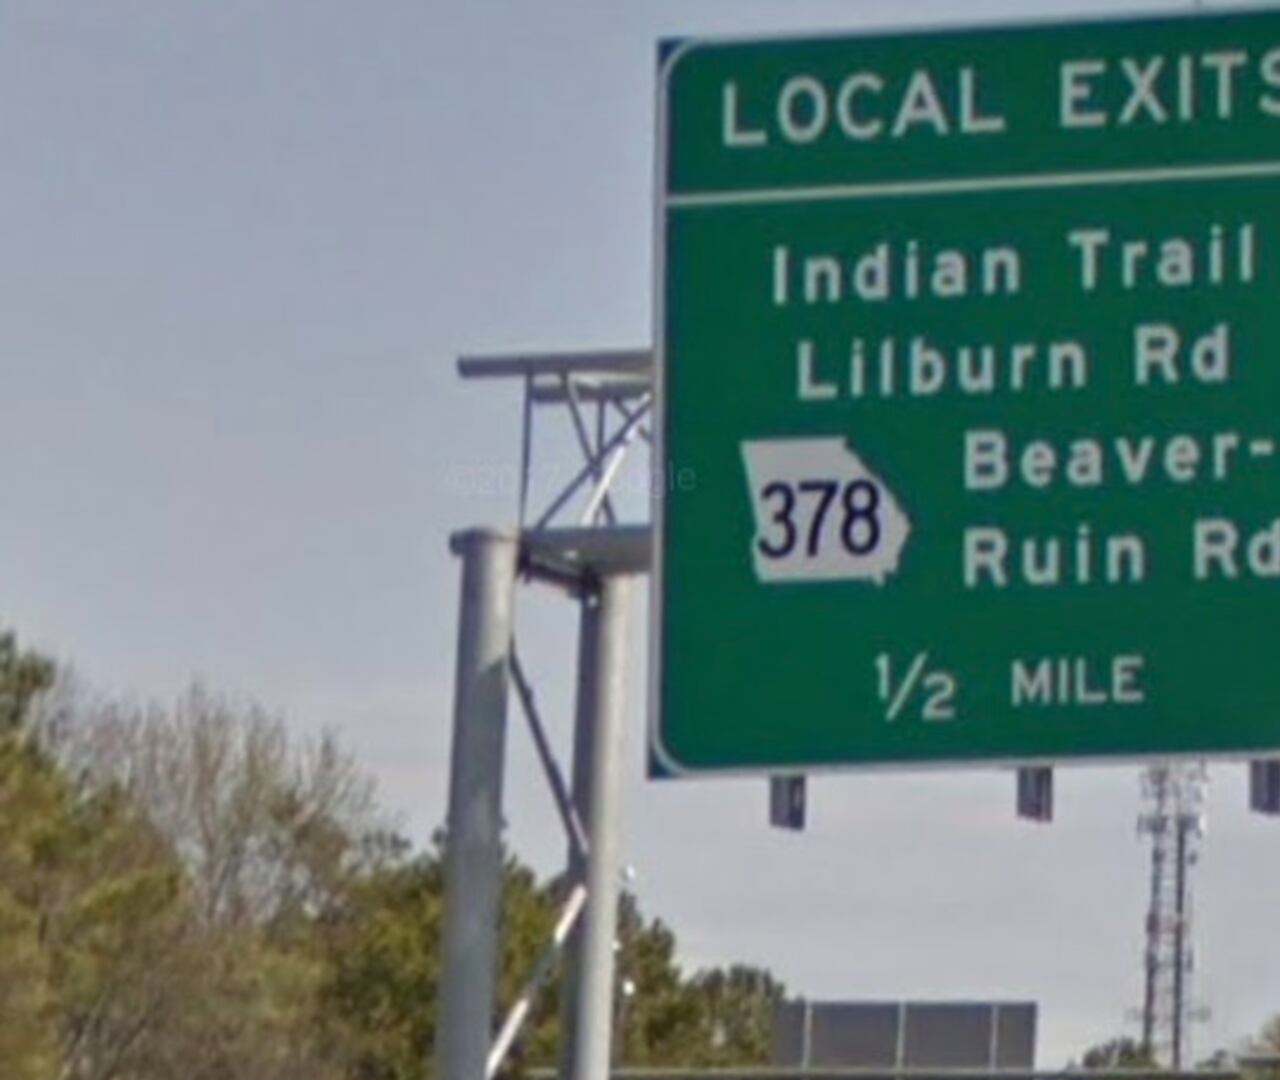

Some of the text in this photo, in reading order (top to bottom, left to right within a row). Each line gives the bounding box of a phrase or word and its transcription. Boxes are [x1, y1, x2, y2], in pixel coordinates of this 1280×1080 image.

[721, 67, 1006, 148] LOCAL
[772, 224, 1256, 305] Indian Trail
[796, 323, 1233, 401] Lilburn Rd
[963, 428, 1276, 492] Beaver-
[757, 479, 883, 558] 378
[963, 524, 1146, 588] Ruin
[1009, 656, 1146, 708] MILE
